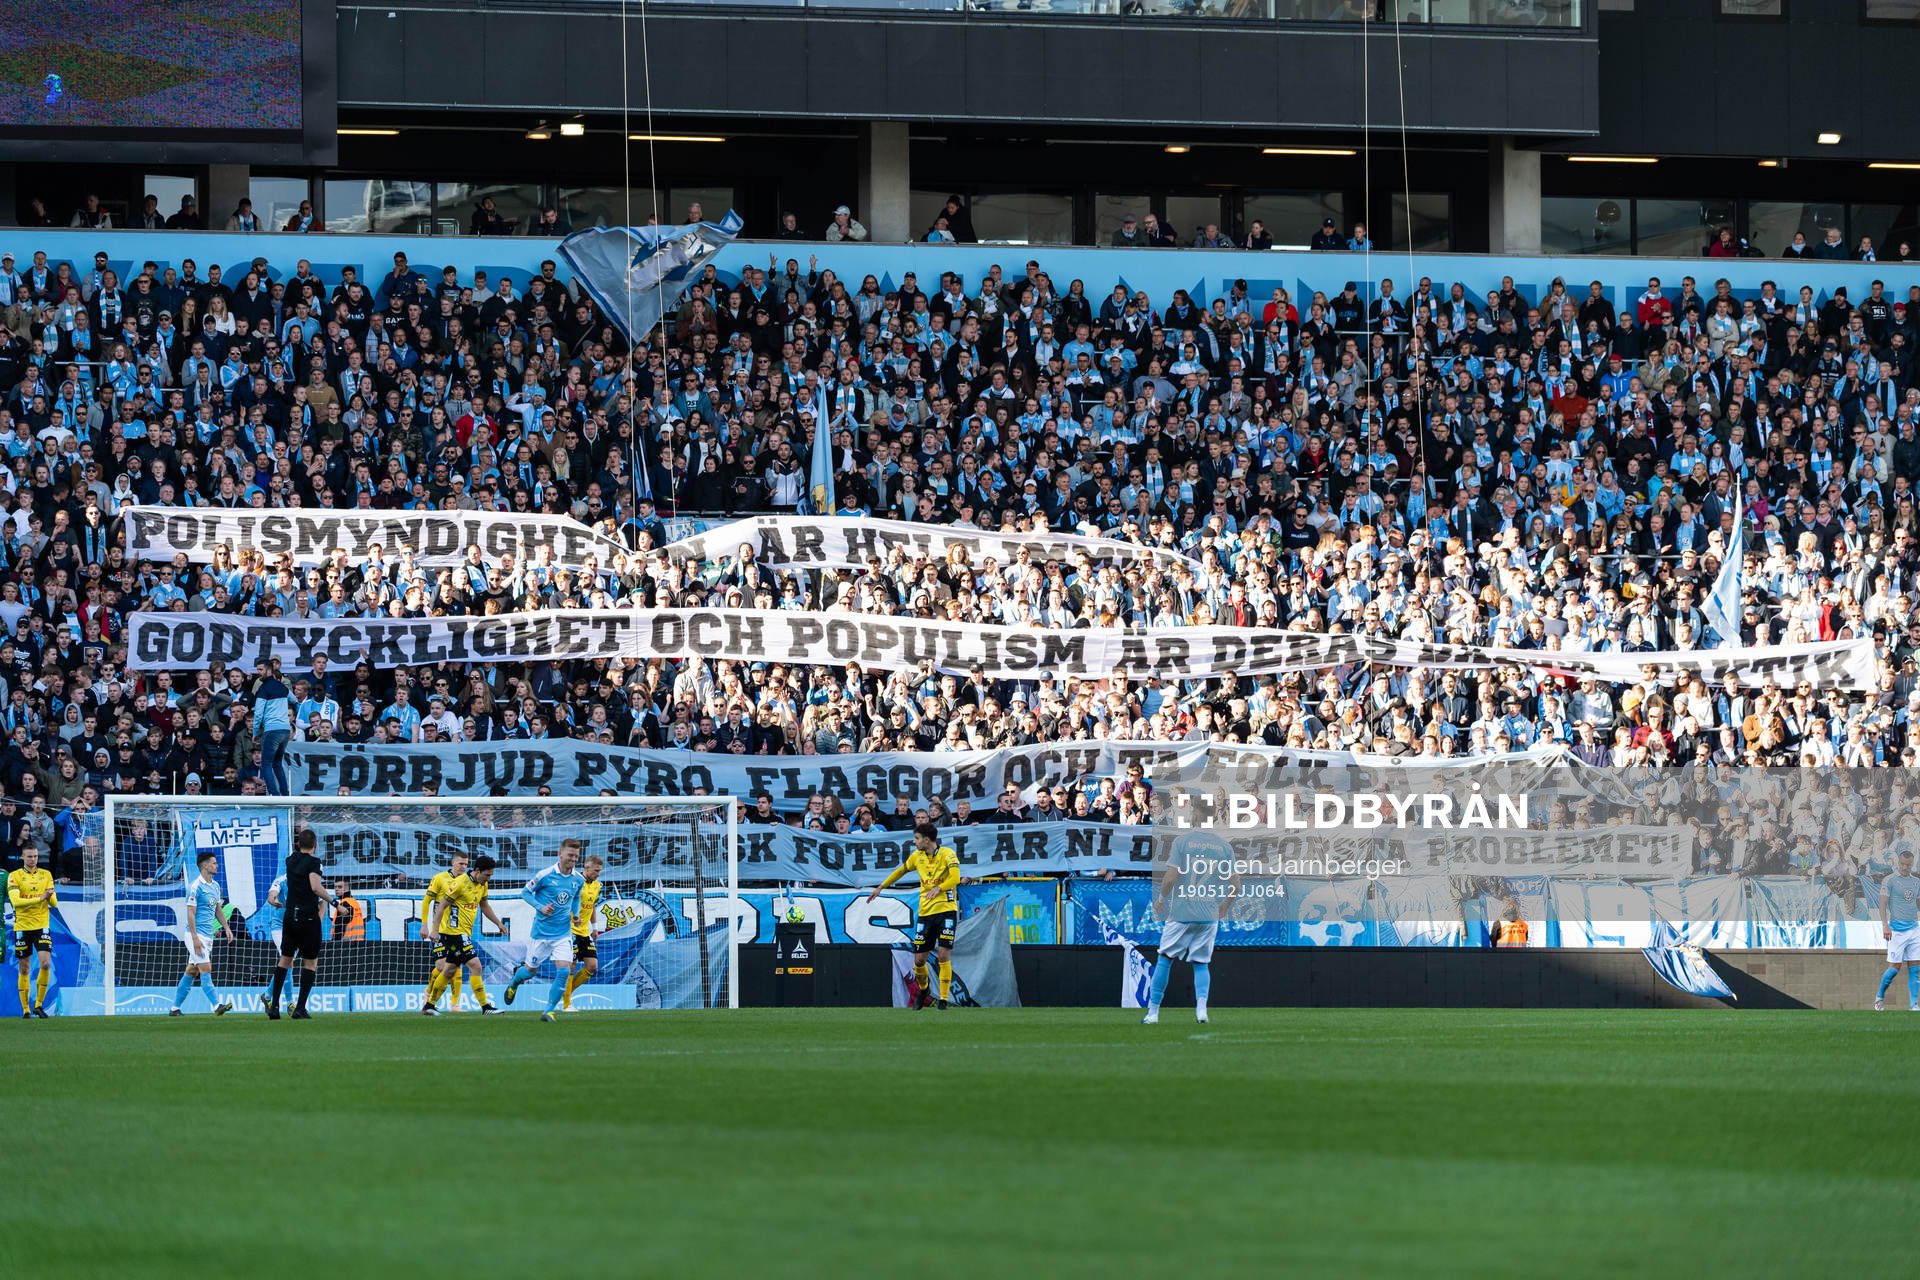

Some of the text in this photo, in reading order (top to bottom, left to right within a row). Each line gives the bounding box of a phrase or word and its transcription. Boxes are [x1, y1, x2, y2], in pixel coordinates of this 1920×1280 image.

[755, 518, 826, 564] ÄR
[136, 614, 632, 666] GODTYCKLIGHET
[649, 612, 765, 656] OCH
[788, 616, 1087, 673] POPULISM
[1115, 628, 1190, 674] ÄR
[1210, 634, 1397, 673] DERAS
[745, 764, 986, 800] FLAGGOR
[1003, 749, 1100, 790] OCH
[1201, 748, 1328, 790] FOLK
[321, 831, 531, 866] POLISEN
[607, 832, 776, 866] SVENSK
[793, 835, 978, 871] FOTBL
[992, 825, 1048, 862] ÄR
[1065, 828, 1114, 857] NI
[1130, 834, 1178, 864] DE
[1427, 834, 1681, 867] PROBLEMET!
[1013, 905, 1040, 920] NOT
[355, 993, 398, 1011] MED
